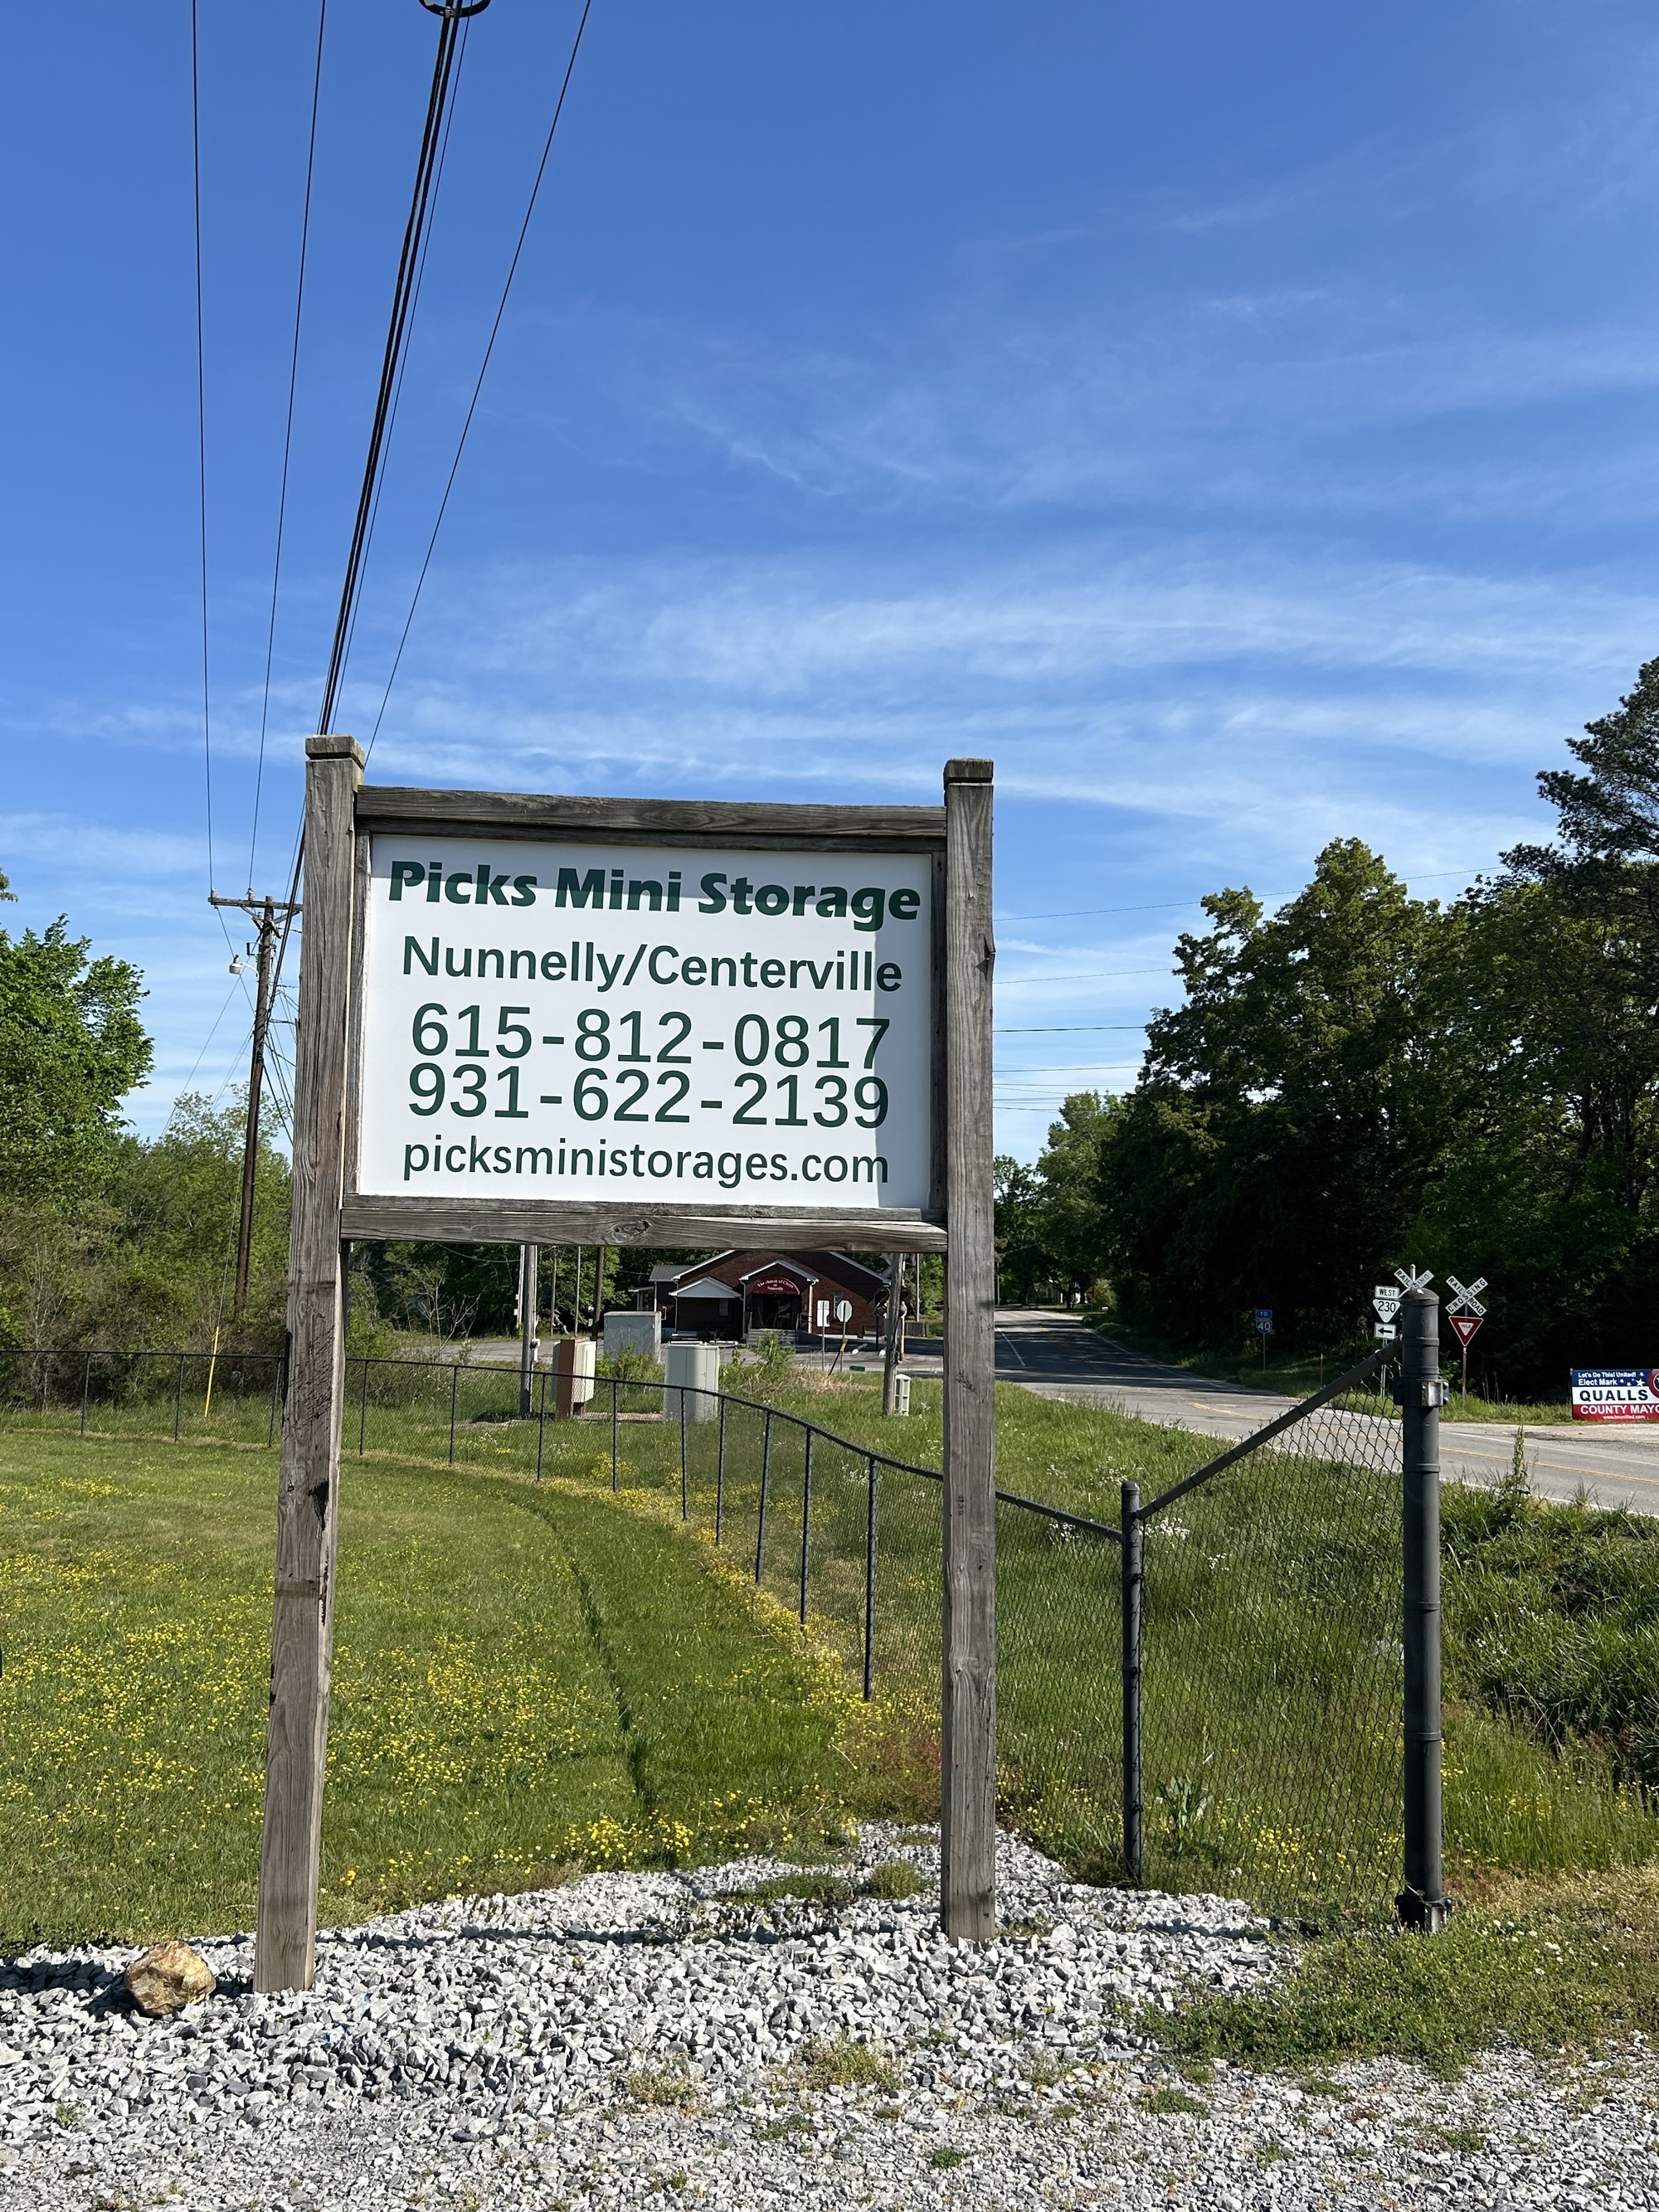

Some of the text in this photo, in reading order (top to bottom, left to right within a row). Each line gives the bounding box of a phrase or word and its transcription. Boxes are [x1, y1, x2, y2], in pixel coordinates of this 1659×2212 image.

[388, 861, 922, 932] Picks Mini Storage
[403, 936, 902, 993] Nunnelly/Centerville
[413, 1003, 891, 1070] 615-812-0817
[408, 1062, 889, 1129] 931-622-2139
[403, 1135, 889, 1189] picksministorages.com
[1379, 1288, 1395, 1296] WEST
[1396, 1270, 1410, 1286] RAIL
[1378, 1300, 1396, 1313] 230
[1447, 1278, 1483, 1314] RAIL ROAD
[1447, 1280, 1486, 1312] CROSSING
[1258, 1322, 1271, 1330] 40
[1579, 1389, 1648, 1402] QUALLS
[1580, 1405, 1627, 1414] COUNTY
